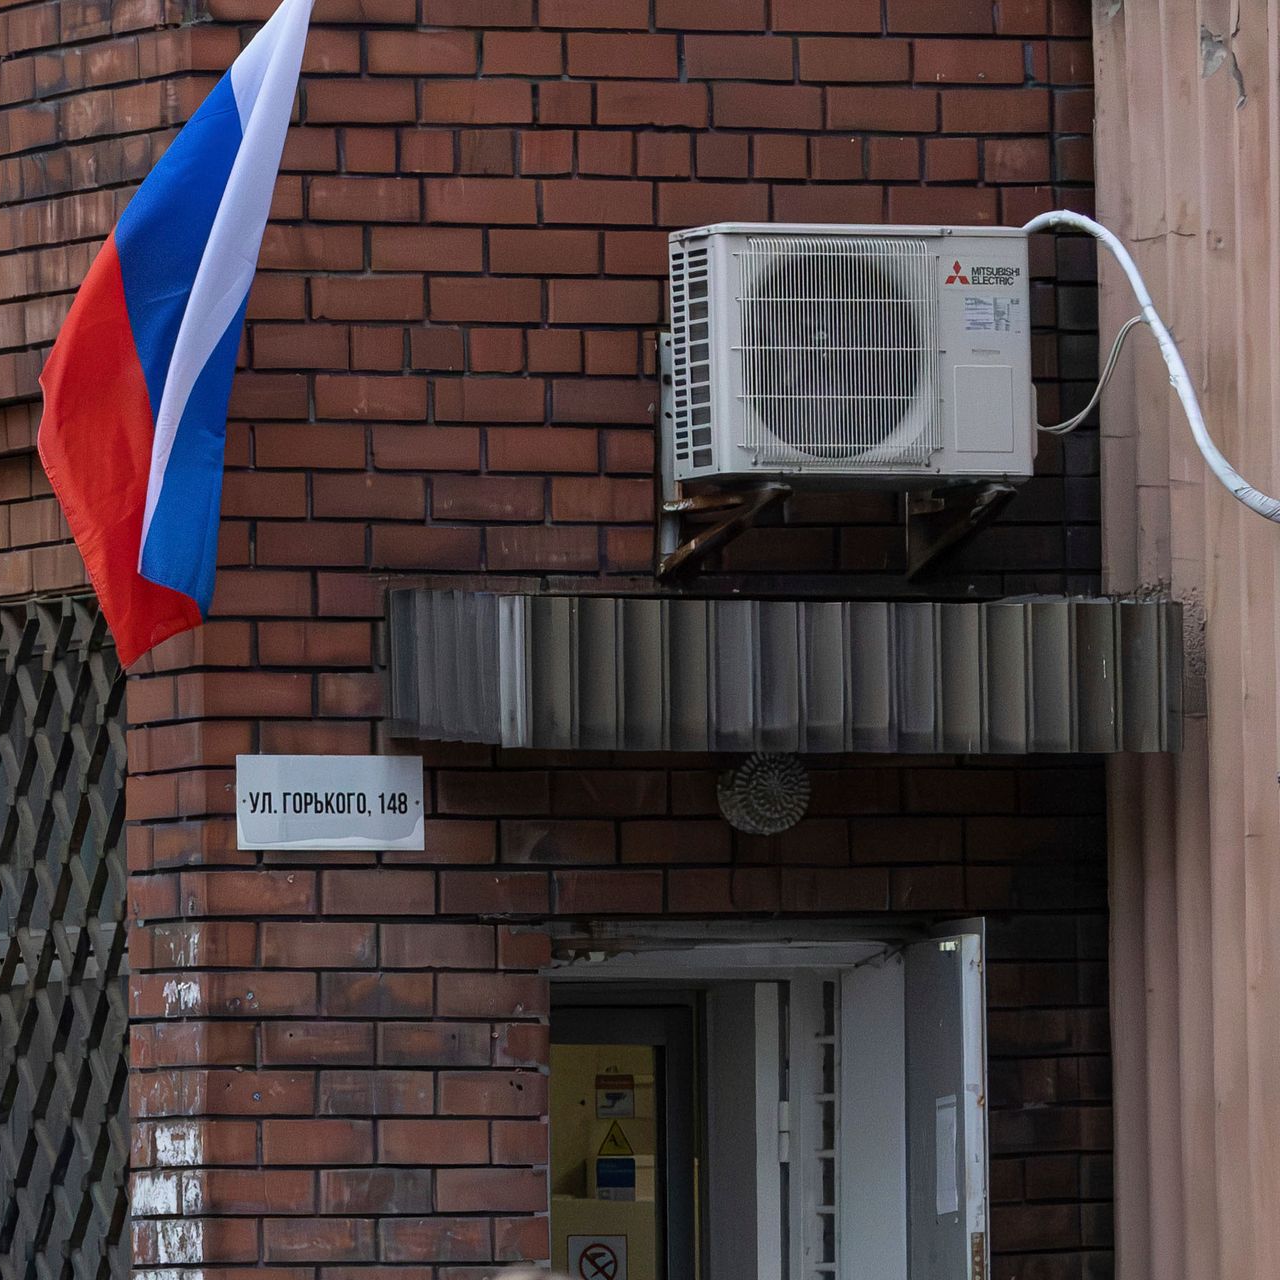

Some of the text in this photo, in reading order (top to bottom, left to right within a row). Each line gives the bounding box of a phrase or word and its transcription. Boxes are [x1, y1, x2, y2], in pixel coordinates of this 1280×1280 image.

[971, 266, 1020, 277] MITSUBISHI
[971, 276, 1015, 286] ELECTRIC
[249, 791, 408, 816] УЛ. ГОРЬКОГО, 148
